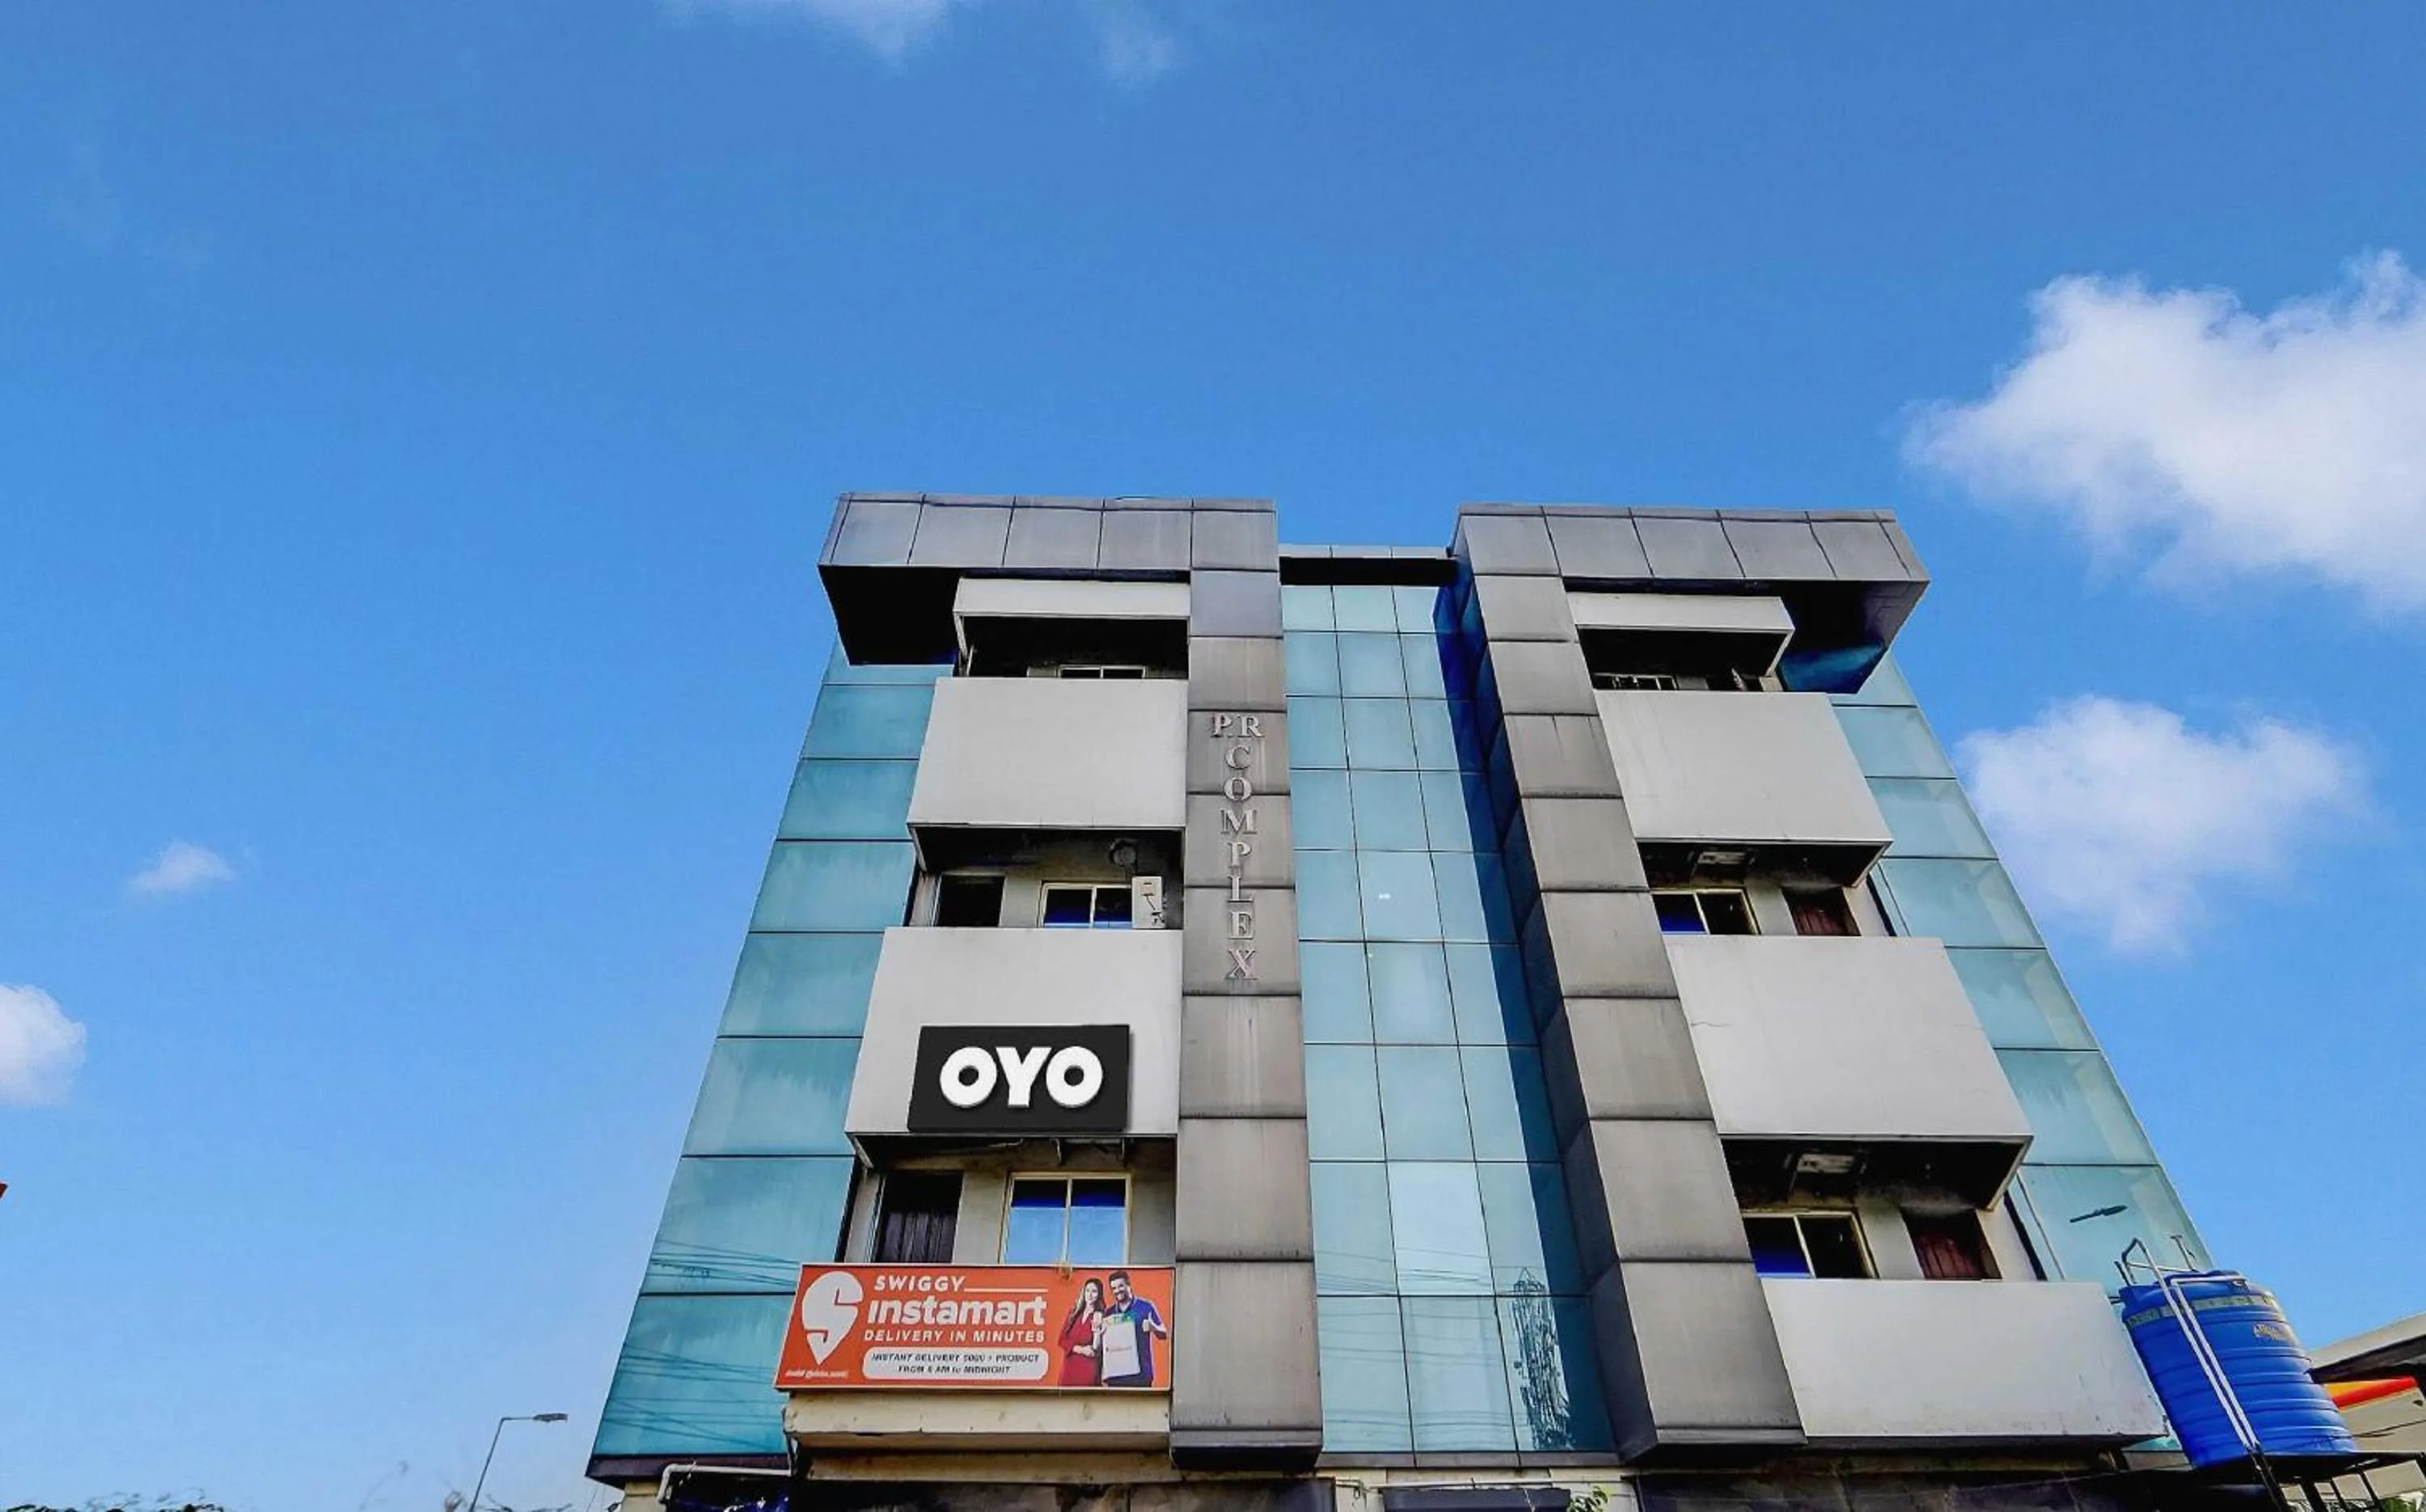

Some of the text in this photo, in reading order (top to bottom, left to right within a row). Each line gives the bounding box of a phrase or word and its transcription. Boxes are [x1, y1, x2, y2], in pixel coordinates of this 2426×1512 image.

[1221, 745, 1258, 981] COMPLEX
[940, 1046, 1103, 1108] OYO
[874, 1275, 966, 1291] SWIGGY
[867, 1294, 1047, 1325] instamart
[864, 1329, 1045, 1343] DELIVERY IN MINUTES
